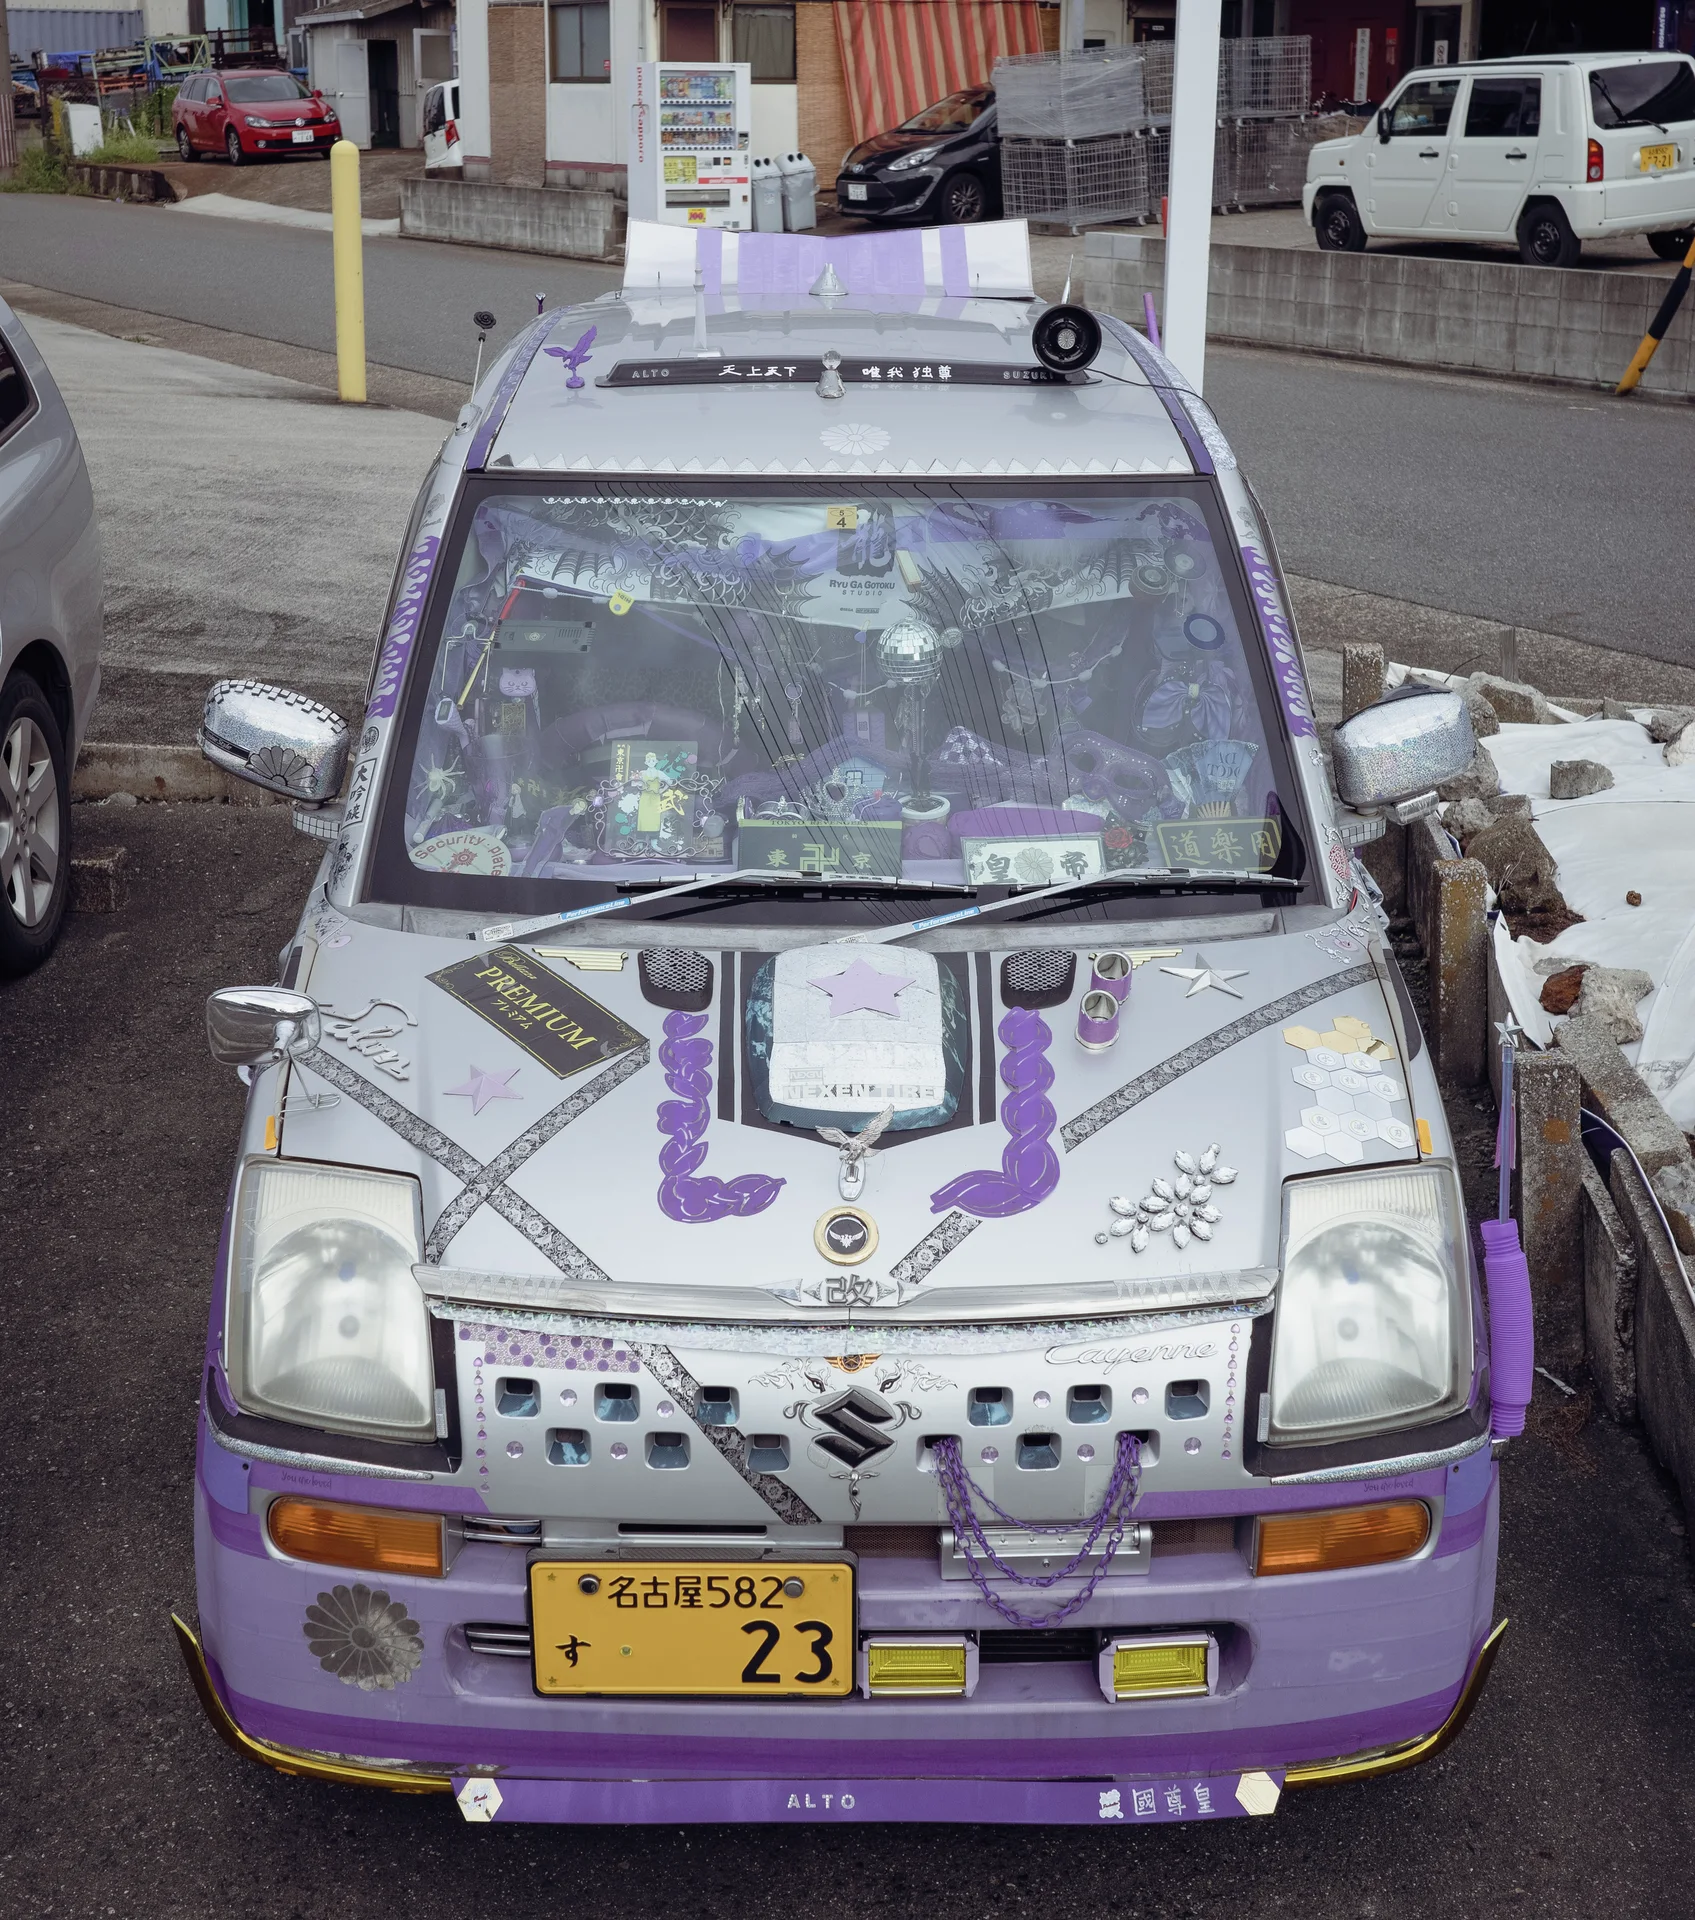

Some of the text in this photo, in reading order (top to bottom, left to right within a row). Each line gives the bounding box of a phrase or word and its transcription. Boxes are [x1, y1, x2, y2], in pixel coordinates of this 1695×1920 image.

[632, 368, 670, 379] ALTO
[718, 364, 797, 378] 天上天下
[836, 517, 847, 528] 4
[842, 589, 883, 597] STUDIO
[415, 834, 506, 877] Security plate
[565, 900, 626, 919] PerformanceLine
[918, 908, 975, 929] PerformanceLine
[474, 965, 598, 1051] PREMIUM
[490, 999, 533, 1030] プレミアム
[825, 1273, 875, 1307] 改
[1044, 1341, 1219, 1375] Cayenne
[555, 1633, 592, 1668] す
[740, 1619, 834, 1684] 23
[787, 1793, 856, 1809] ALTO
